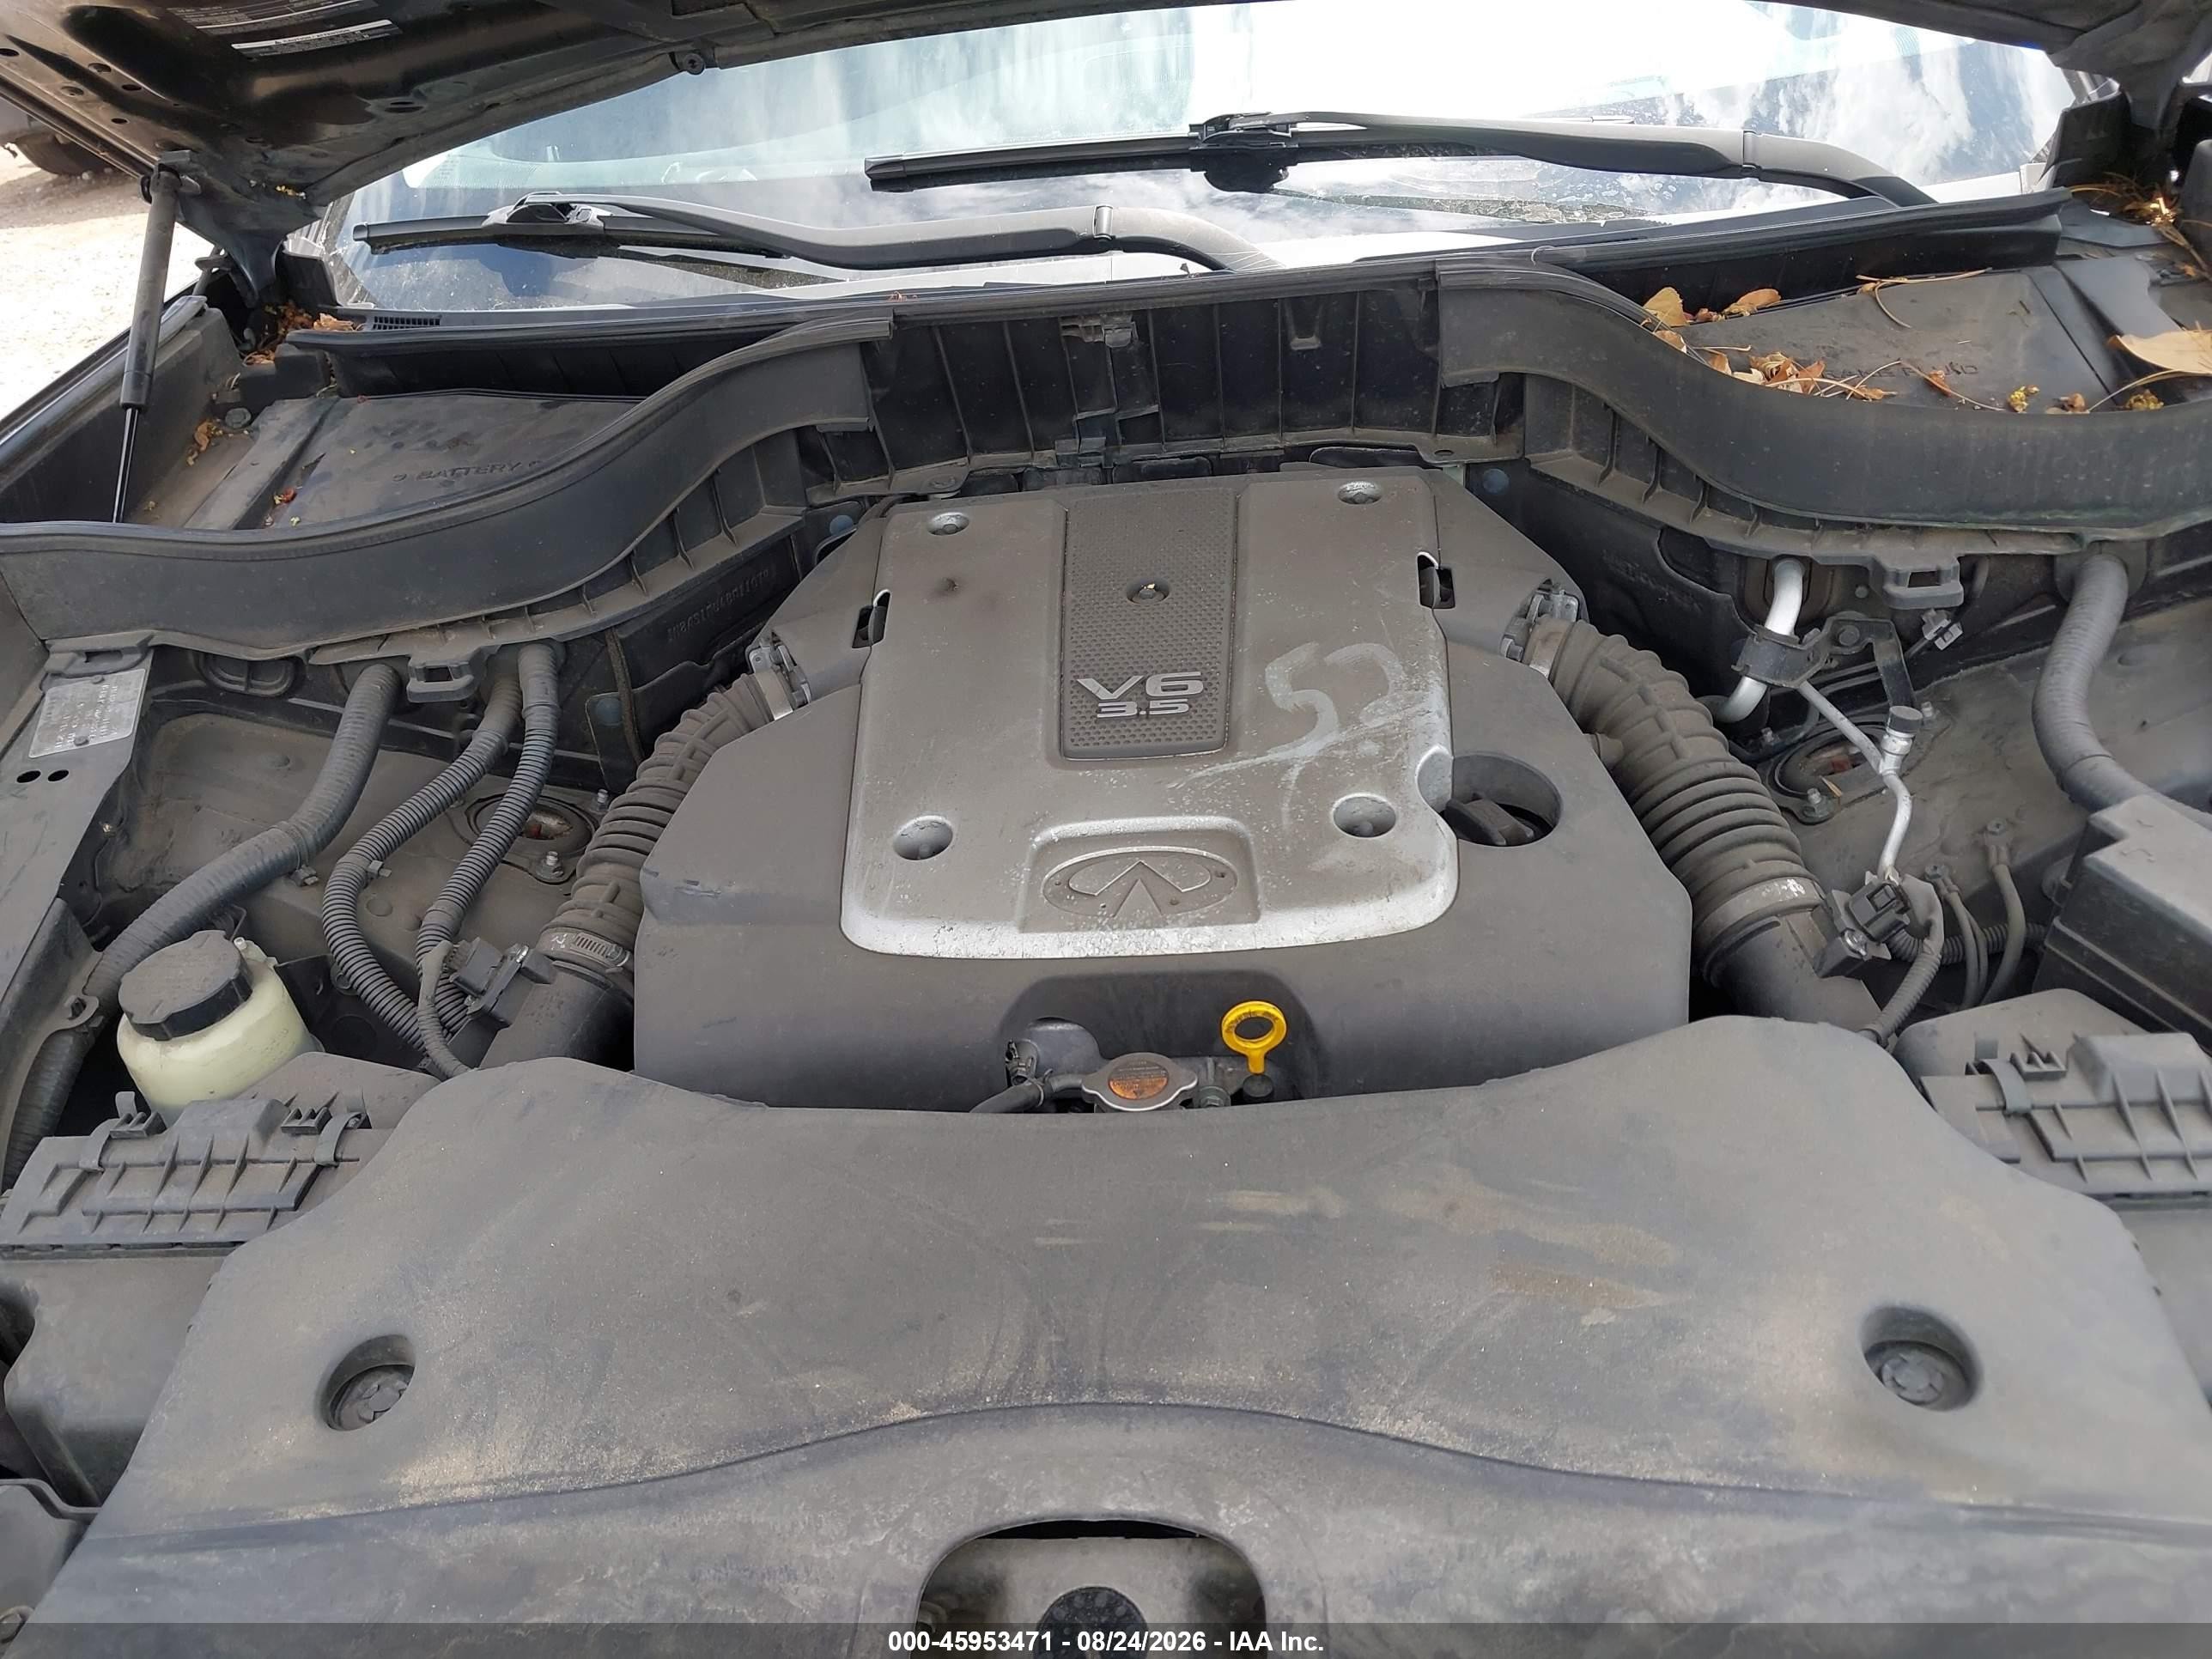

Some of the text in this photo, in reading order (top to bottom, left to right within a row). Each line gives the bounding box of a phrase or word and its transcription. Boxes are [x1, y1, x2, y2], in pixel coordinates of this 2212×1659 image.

[416, 462, 521, 481] BATTERY
[1076, 671, 1204, 700] V6
[1097, 698, 1190, 718] 3.5
